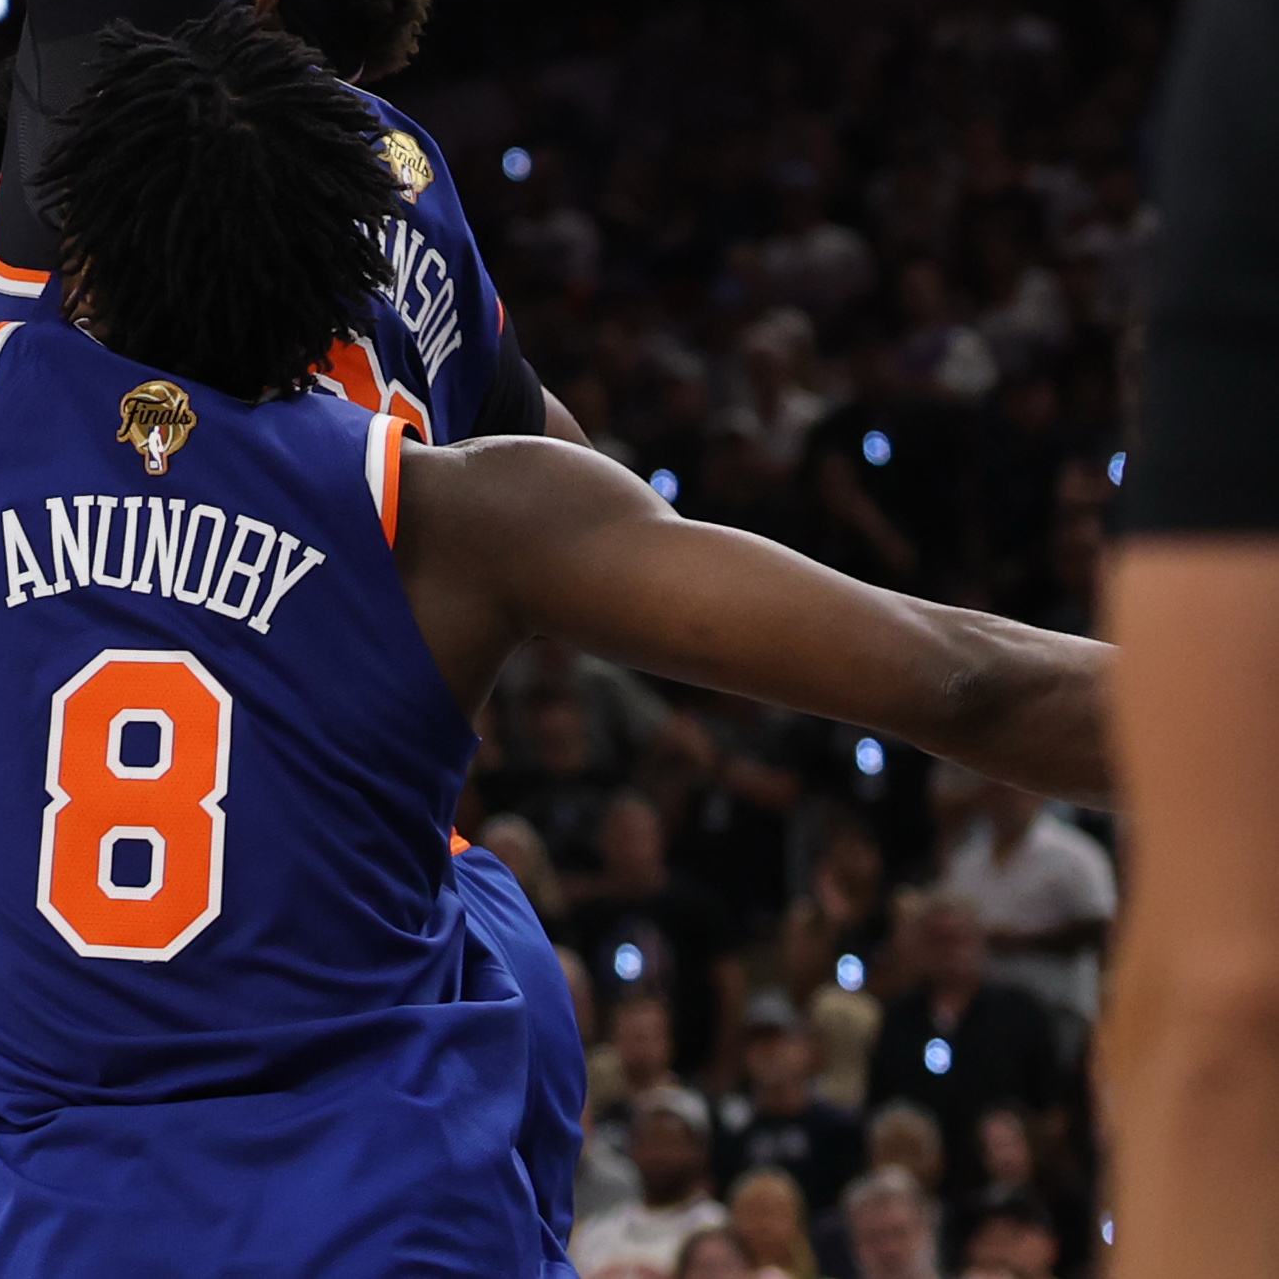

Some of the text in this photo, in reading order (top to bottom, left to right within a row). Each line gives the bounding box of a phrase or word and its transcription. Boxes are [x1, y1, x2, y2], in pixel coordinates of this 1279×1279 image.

[118, 397, 193, 439] Finals
[0, 494, 327, 635] ANUNOBY
[35, 648, 234, 963] 8
